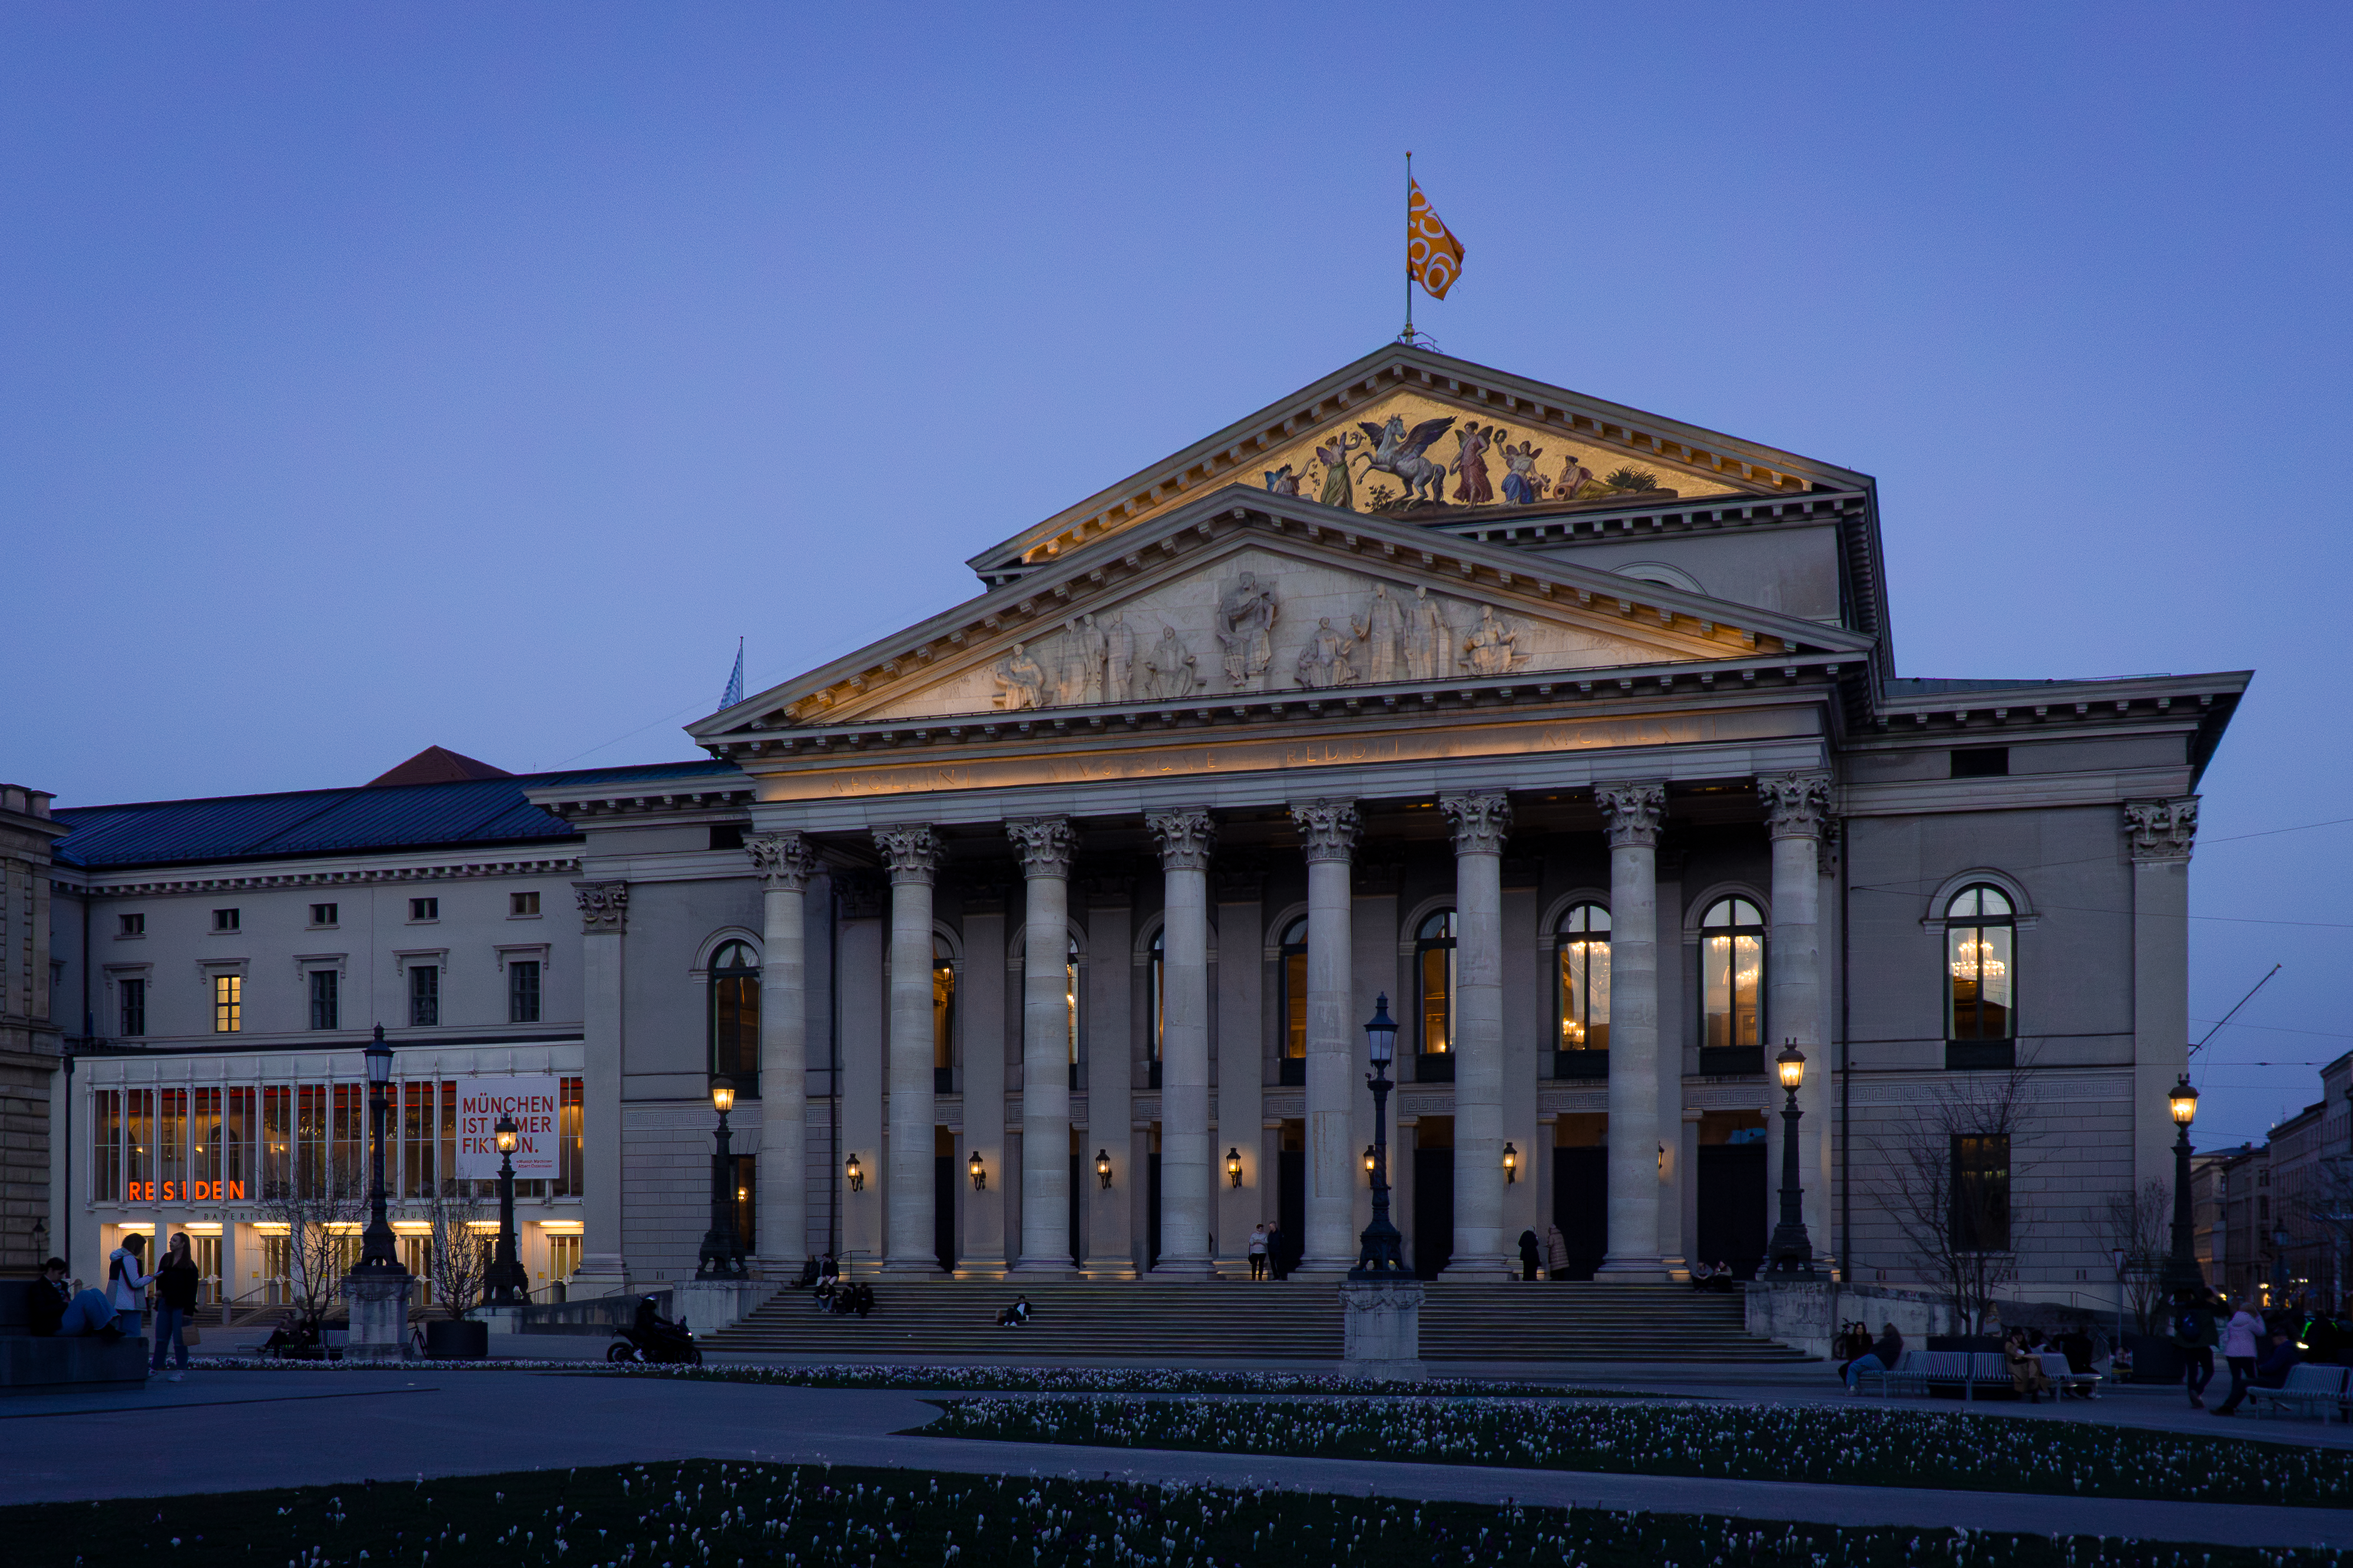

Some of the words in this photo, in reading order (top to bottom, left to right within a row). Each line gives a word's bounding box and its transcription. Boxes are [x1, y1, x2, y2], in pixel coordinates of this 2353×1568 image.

[829, 768, 971, 793] APOLLINI
[1047, 752, 1216, 779] MVSSQVE
[463, 1092, 554, 1114] MÜNCHEN
[462, 1118, 488, 1134] IST
[494, 1116, 552, 1134] IMER
[462, 1137, 539, 1154] FIKTN.
[129, 1181, 244, 1201] RESIDEN
